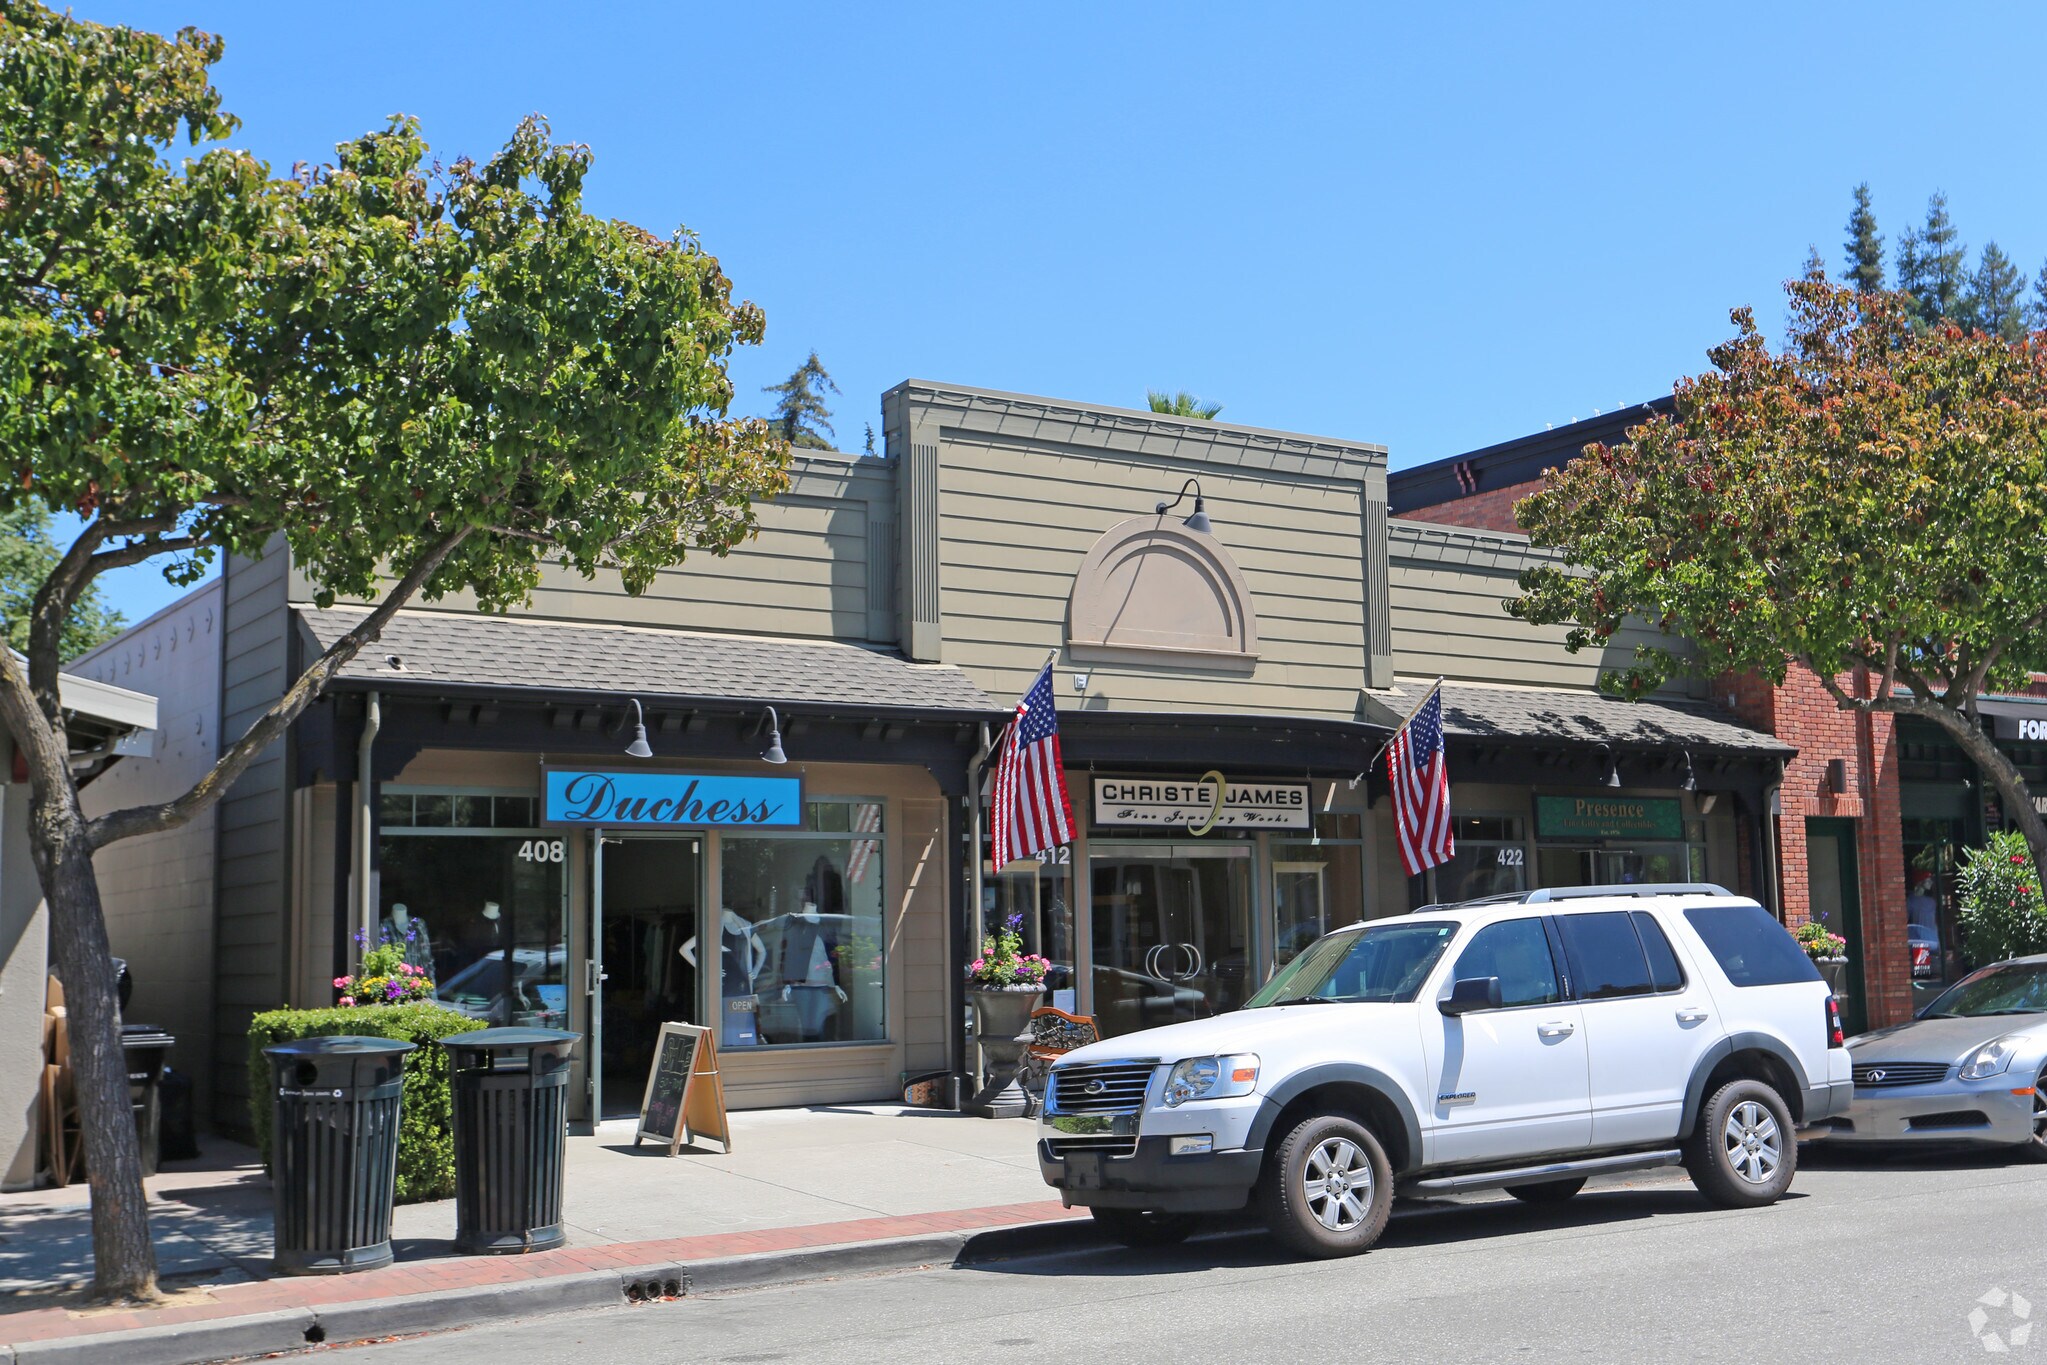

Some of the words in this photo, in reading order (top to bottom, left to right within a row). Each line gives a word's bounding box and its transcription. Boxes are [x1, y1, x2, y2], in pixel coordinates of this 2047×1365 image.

[564, 773, 784, 823] Duchess
[1102, 784, 1211, 803] CHRISTE
[1225, 788, 1303, 805] JAMES
[1117, 809, 1157, 819] Fine
[1243, 812, 1289, 823] Works
[1574, 799, 1645, 818] Presence
[518, 840, 565, 863] 408
[1035, 845, 1070, 865] 412
[1497, 849, 1524, 866] 422
[732, 1001, 752, 1010] OPEN
[1440, 1092, 1476, 1100] EXPLORER
